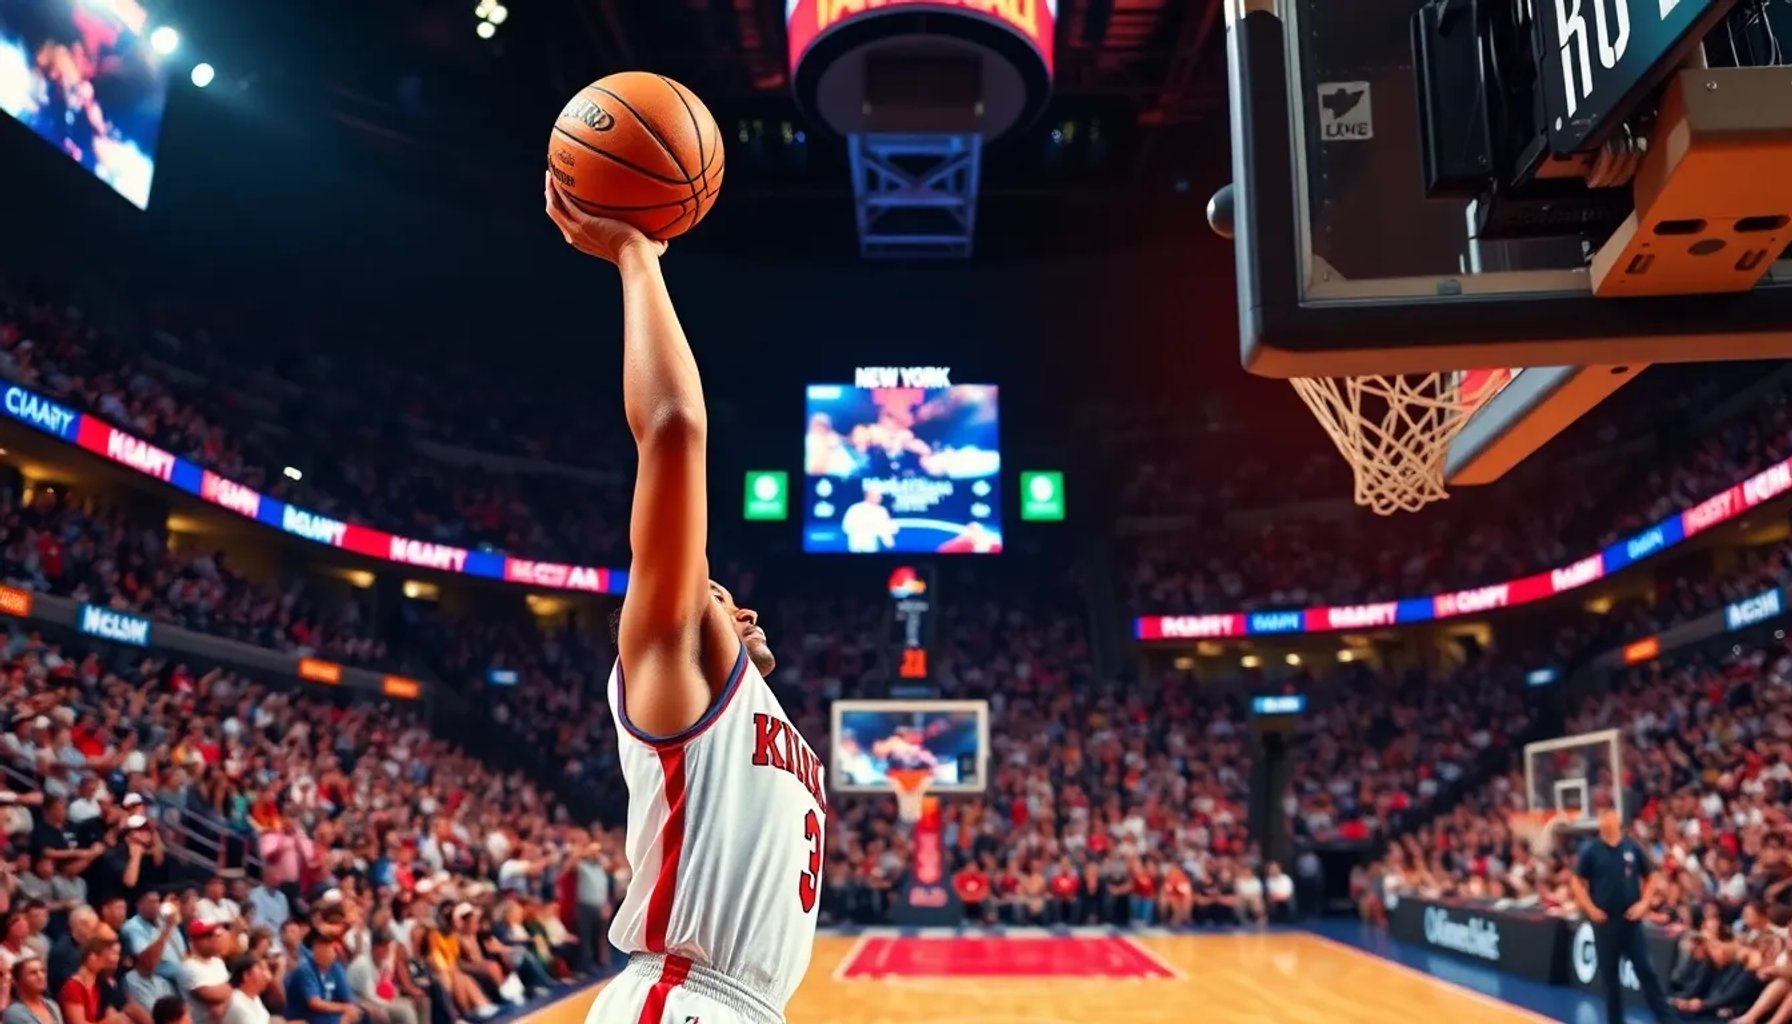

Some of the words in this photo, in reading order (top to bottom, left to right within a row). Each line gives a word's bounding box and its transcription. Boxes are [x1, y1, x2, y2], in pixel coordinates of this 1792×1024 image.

[855, 367, 899, 388] NEW
[899, 367, 951, 388] YORK
[799, 808, 822, 914] 3
